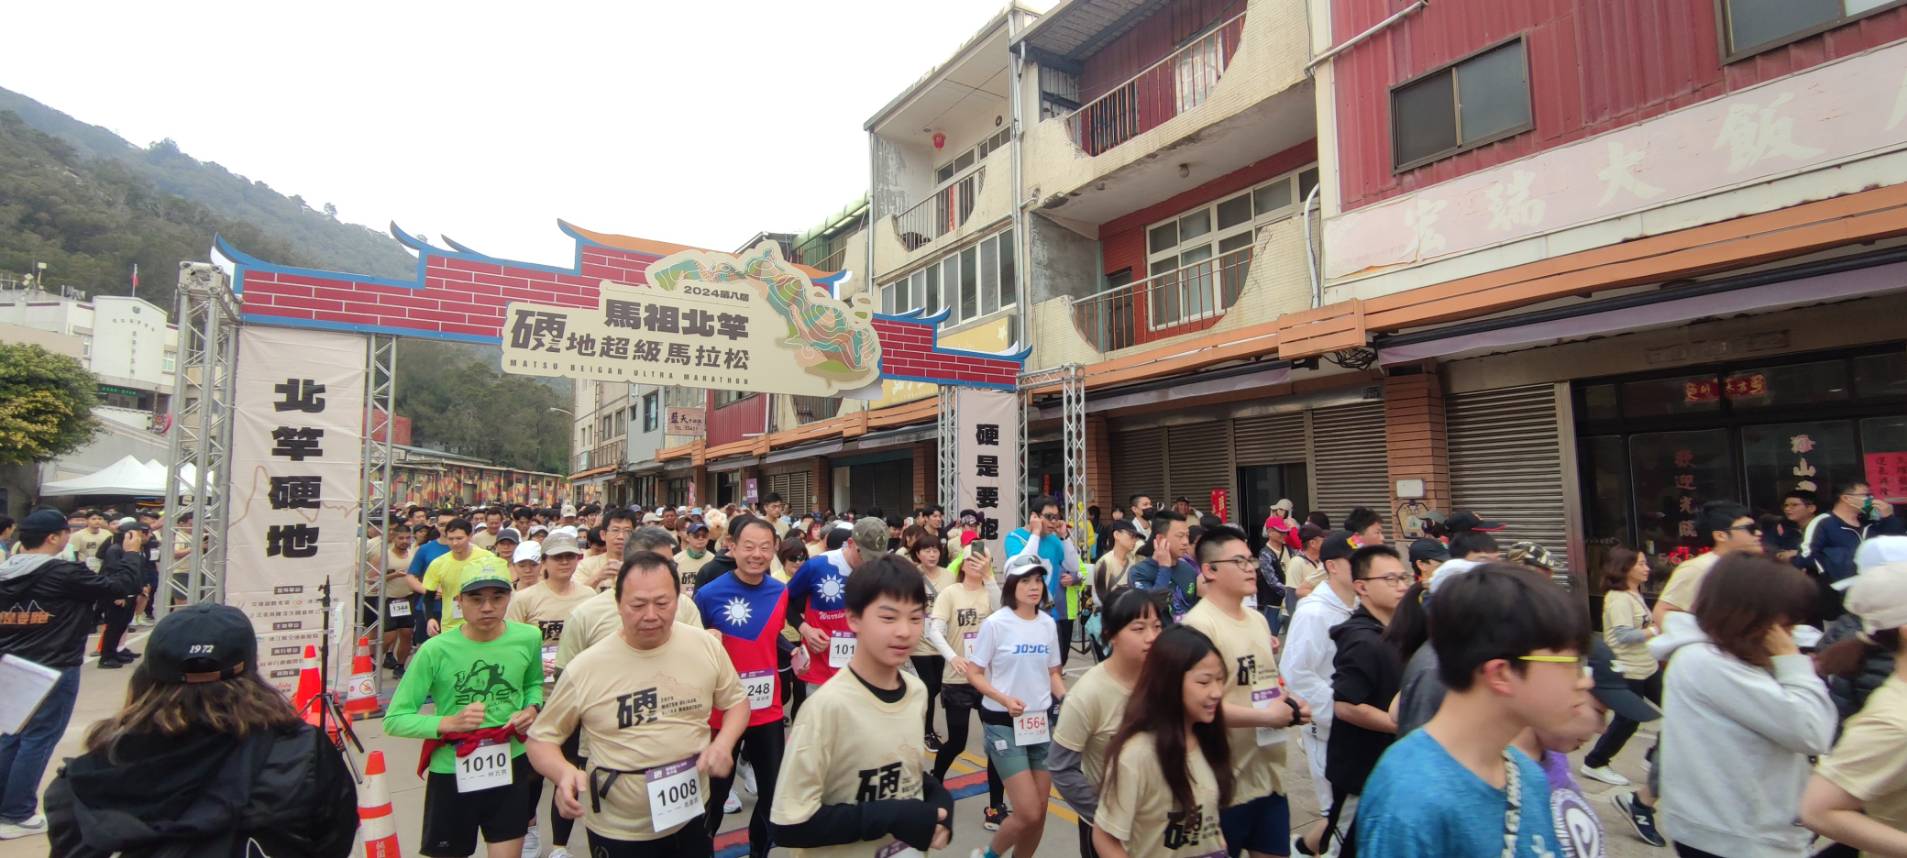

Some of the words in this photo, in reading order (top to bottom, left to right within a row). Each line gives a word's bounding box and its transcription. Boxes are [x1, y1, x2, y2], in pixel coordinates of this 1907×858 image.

[1399, 66, 1907, 259] 宏瑞大飯
[604, 299, 749, 341] 馬祖北竿
[511, 309, 750, 370] 硬地超級馬拉松
[510, 359, 558, 370] MATSU
[570, 364, 623, 376] BEIGAN
[633, 369, 673, 380] ULTRA
[683, 373, 749, 385] MARATHON
[266, 378, 326, 559] 北竿硬地
[975, 423, 999, 540] 硬是要跑
[957, 608, 977, 627] 硬
[189, 644, 214, 654] 1972
[617, 687, 657, 730] 硬
[1019, 717, 1045, 730] 1564
[462, 752, 506, 773] 1010
[657, 778, 698, 807] 1008
